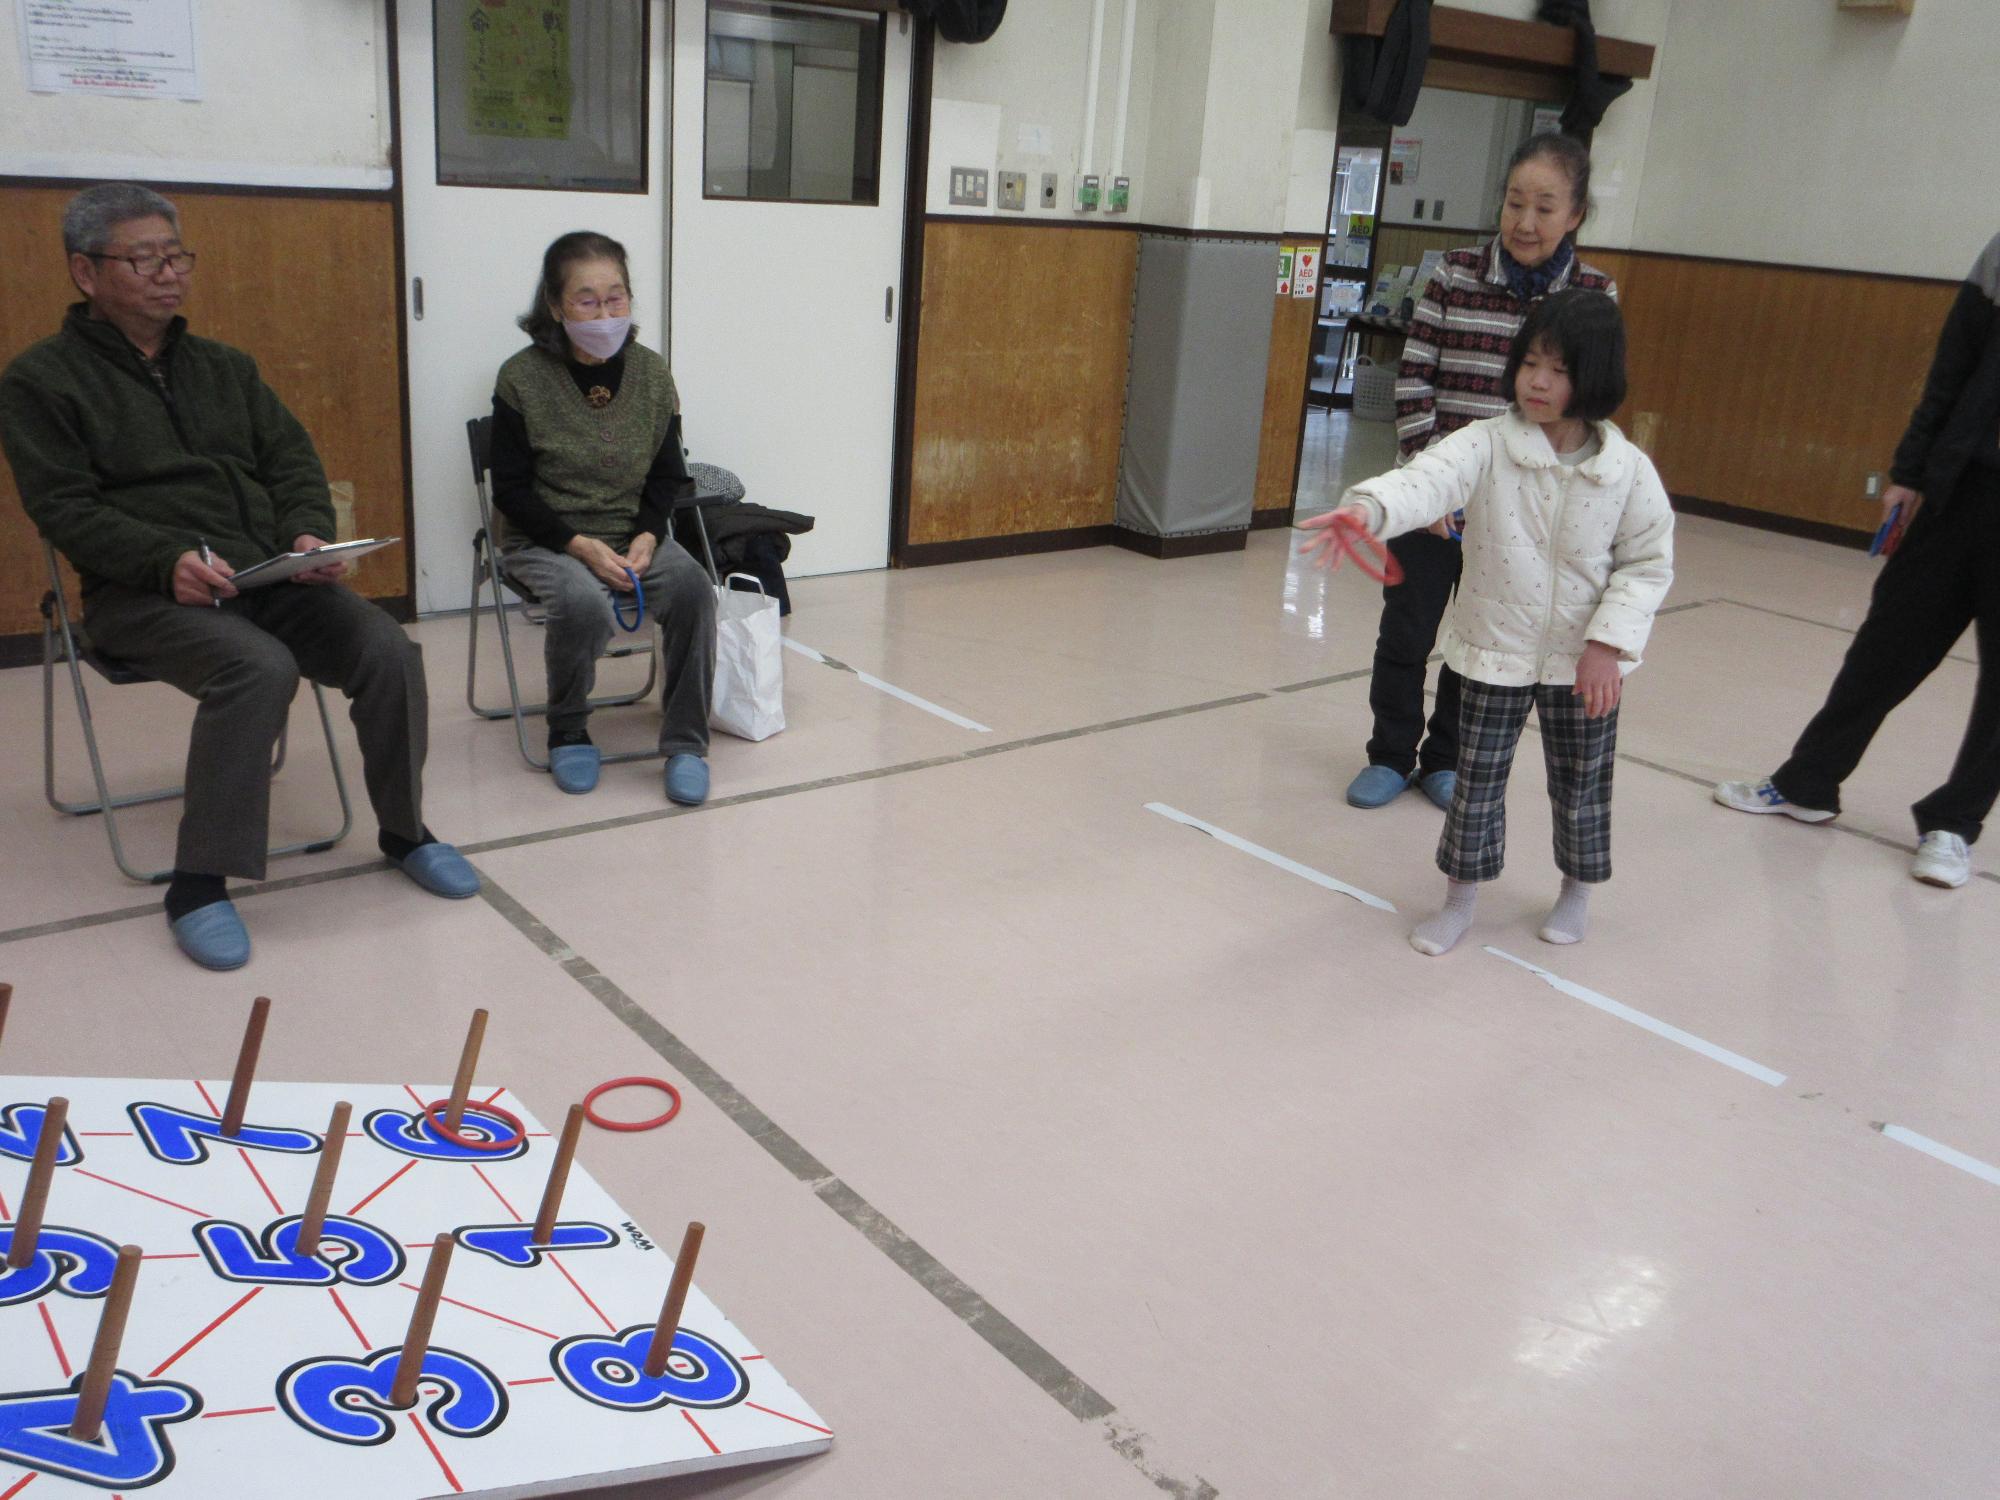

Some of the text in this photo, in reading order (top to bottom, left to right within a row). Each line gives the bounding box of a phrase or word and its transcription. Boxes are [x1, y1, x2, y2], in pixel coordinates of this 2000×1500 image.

[1299, 268, 1314, 278] AED
[125, 1101, 325, 1165] 7
[362, 1108, 530, 1163] 6
[193, 1215, 407, 1287] 5
[452, 1220, 620, 1268] 1
[275, 1345, 510, 1447] 3
[549, 1323, 750, 1411] 8
[0, 1368, 204, 1490] 4
